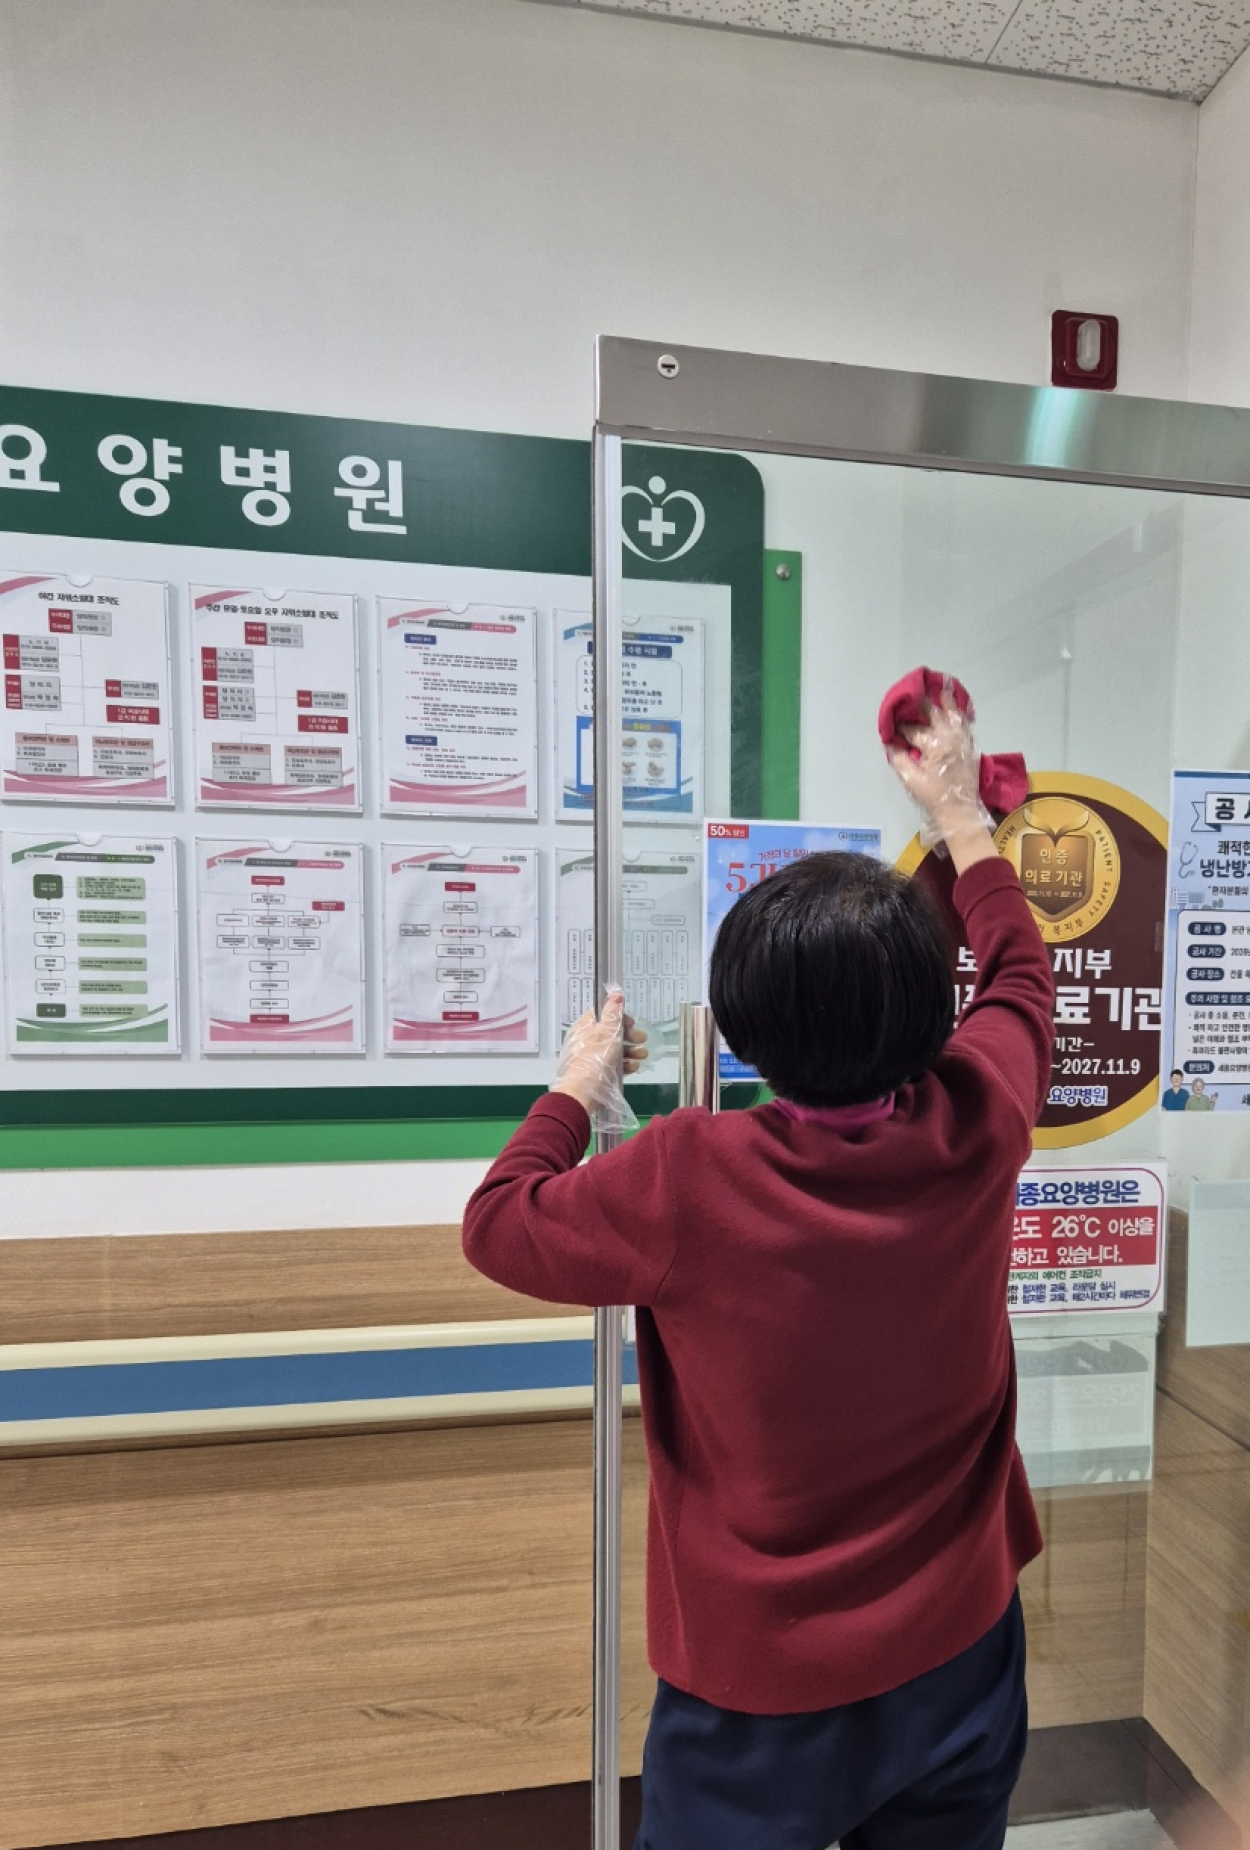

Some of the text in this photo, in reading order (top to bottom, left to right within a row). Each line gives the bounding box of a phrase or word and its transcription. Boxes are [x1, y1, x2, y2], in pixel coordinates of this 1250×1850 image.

[710, 826, 731, 837] 50%
[1108, 1216, 1155, 1237] 이상을
[1057, 1245, 1123, 1264] 있습니다.
